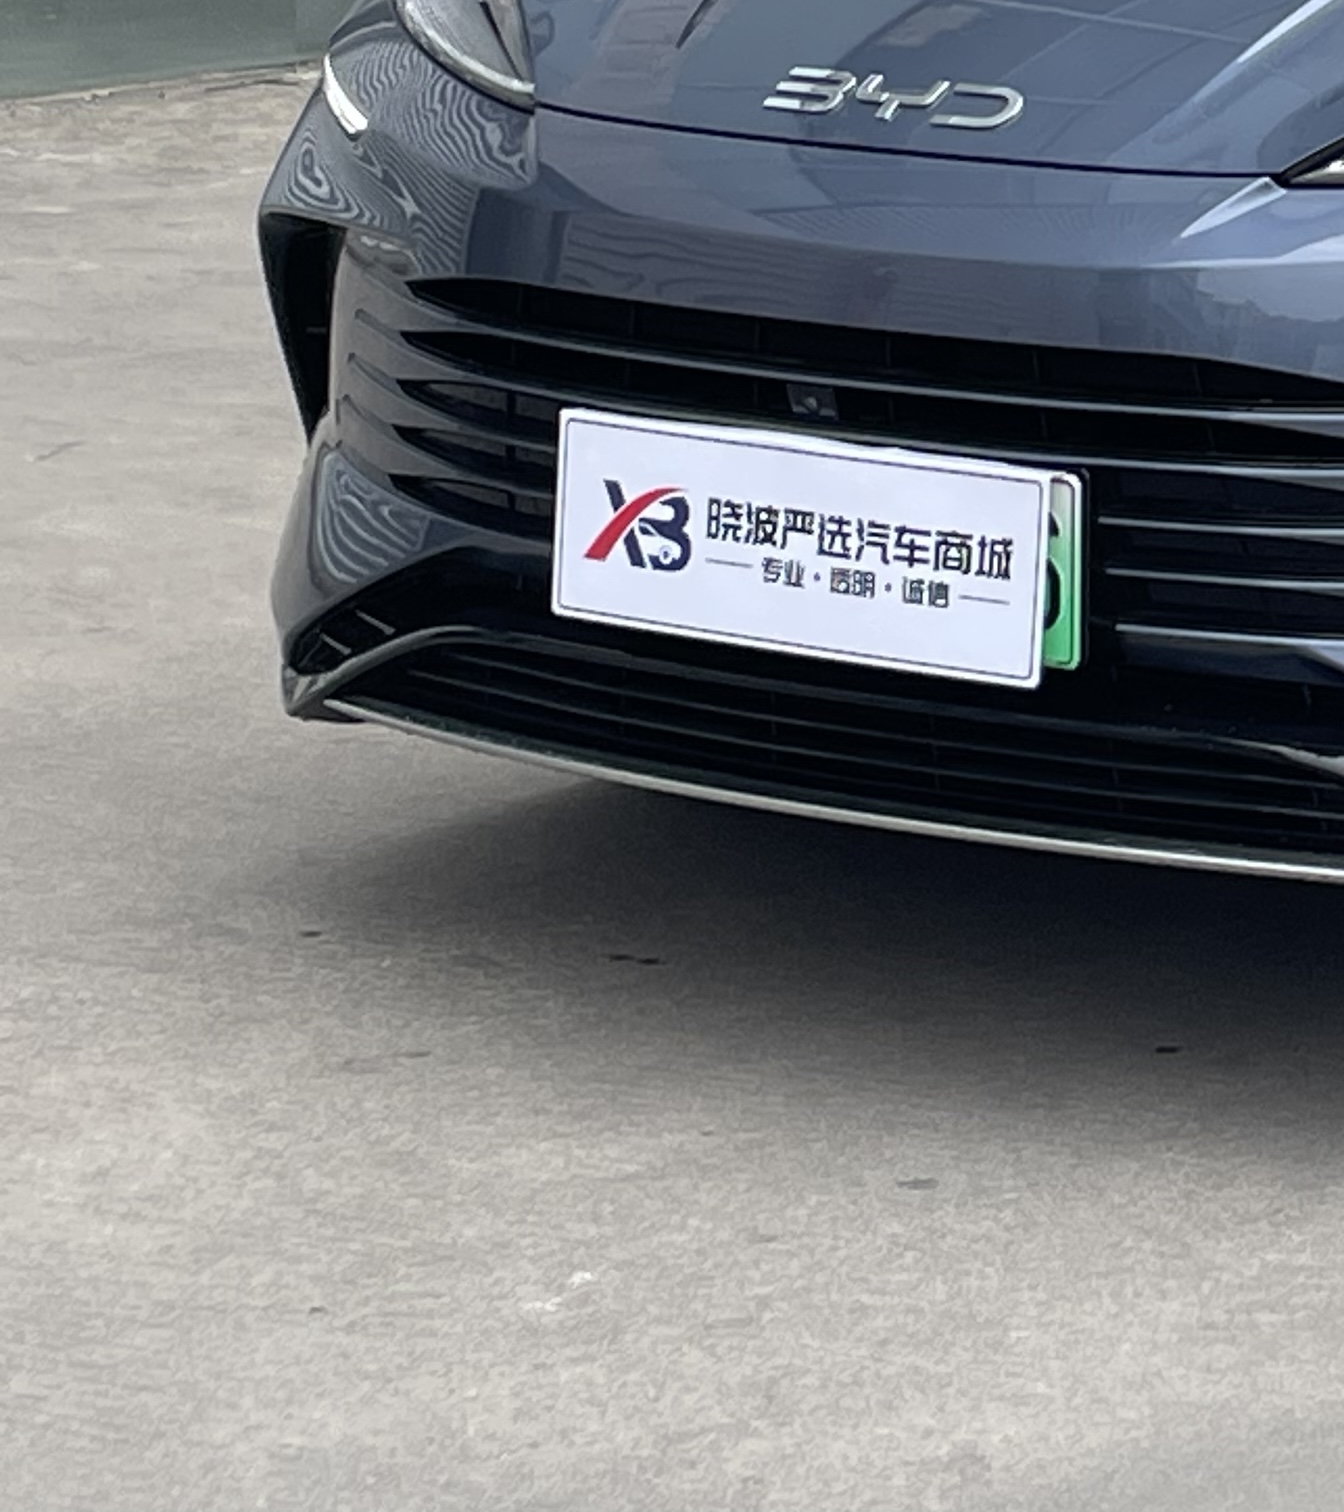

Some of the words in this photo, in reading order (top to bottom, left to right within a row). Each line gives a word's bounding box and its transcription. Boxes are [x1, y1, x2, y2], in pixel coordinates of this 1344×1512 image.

[762, 65, 1024, 131] BYD
[705, 496, 1014, 581] 晓波严选汽车商城
